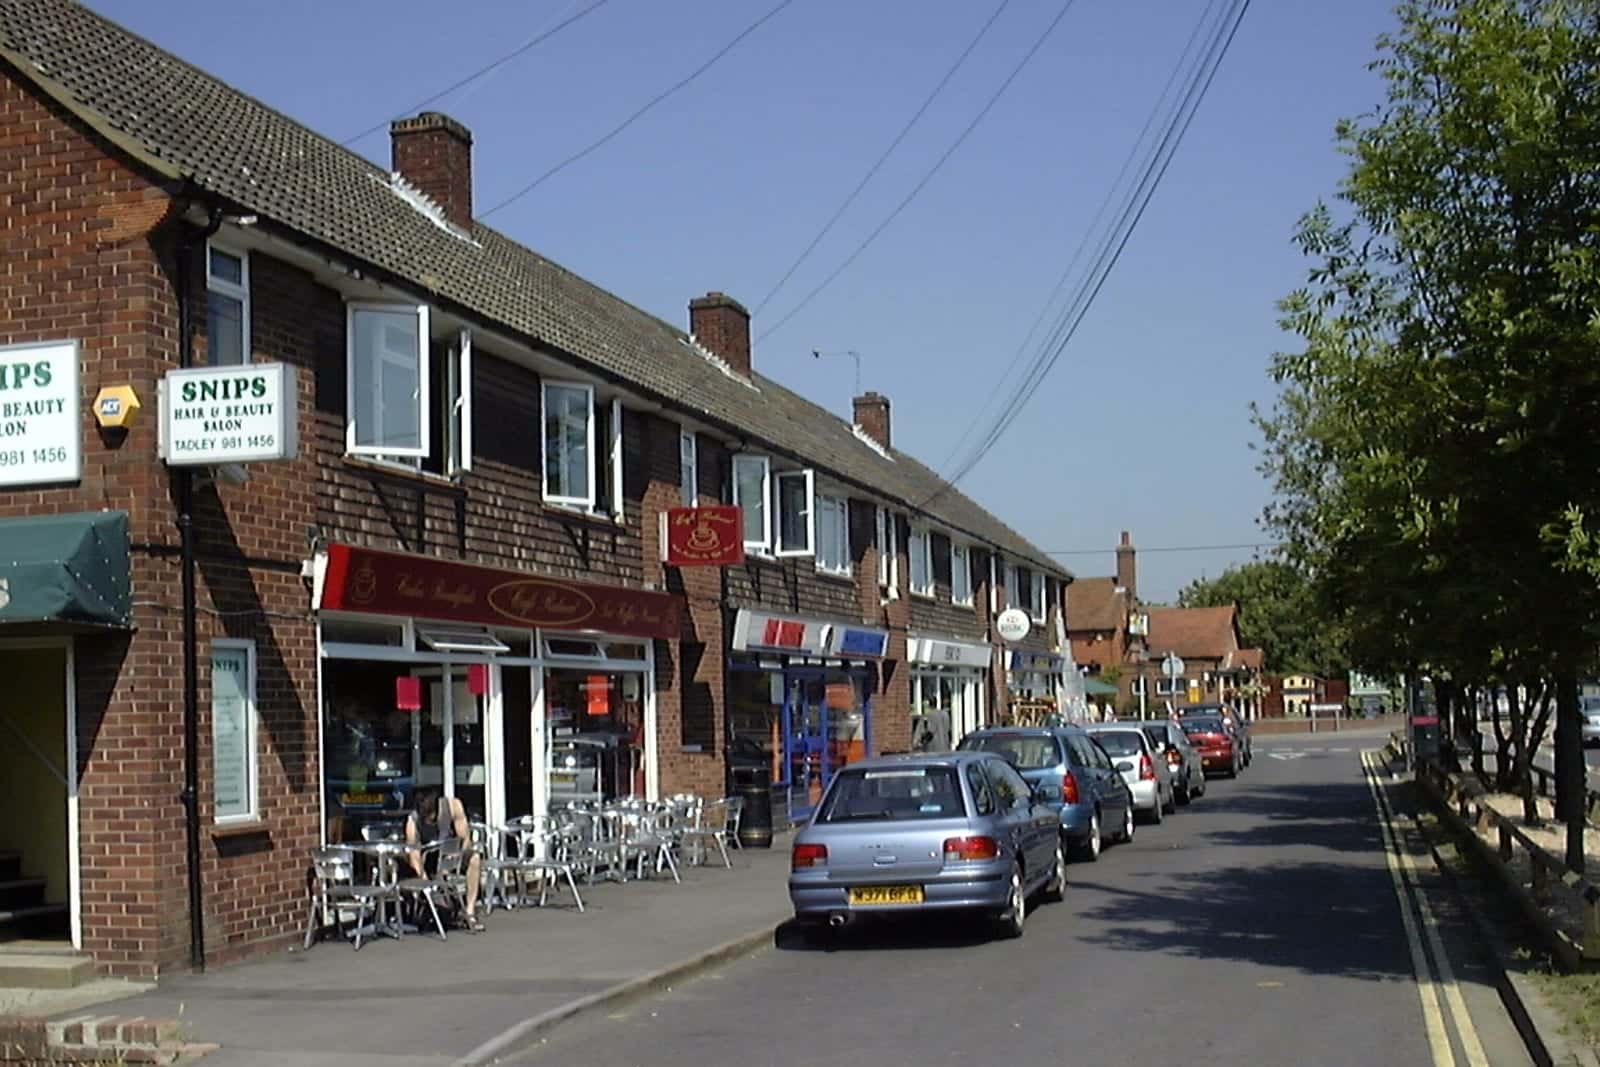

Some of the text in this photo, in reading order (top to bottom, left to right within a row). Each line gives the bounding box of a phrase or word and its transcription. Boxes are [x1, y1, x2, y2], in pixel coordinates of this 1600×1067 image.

[182, 376, 267, 403] SNIPS
[3, 398, 65, 418] BEAUTY
[174, 407, 205, 420] HAIR
[225, 402, 274, 418] BEAUTY
[204, 418, 243, 433] SALON
[175, 434, 275, 451] TADLEY 981 1456
[0, 446, 67, 467] 981 1456
